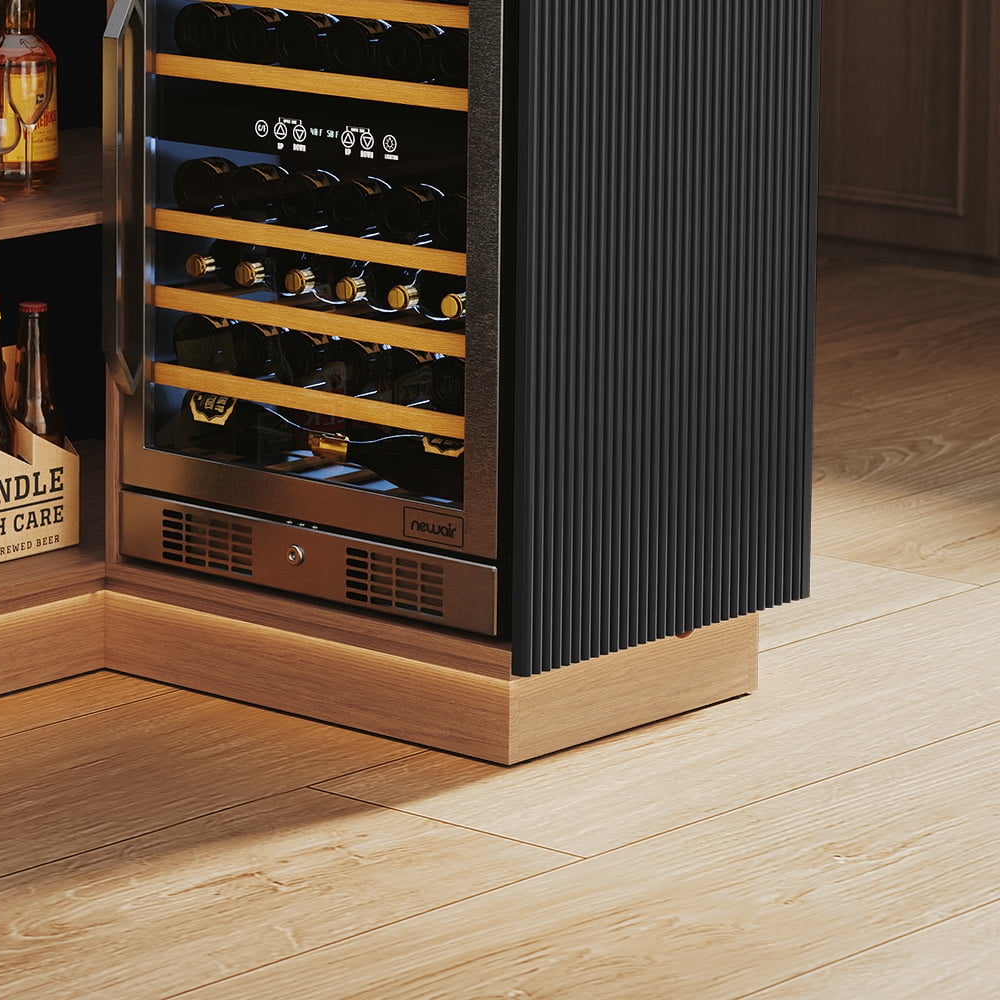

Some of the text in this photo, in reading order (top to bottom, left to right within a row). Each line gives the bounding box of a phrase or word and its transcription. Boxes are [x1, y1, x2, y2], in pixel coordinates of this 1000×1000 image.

[13, 504, 64, 532] CARE
[411, 520, 457, 538] newair
[36, 534, 60, 547] BEER
